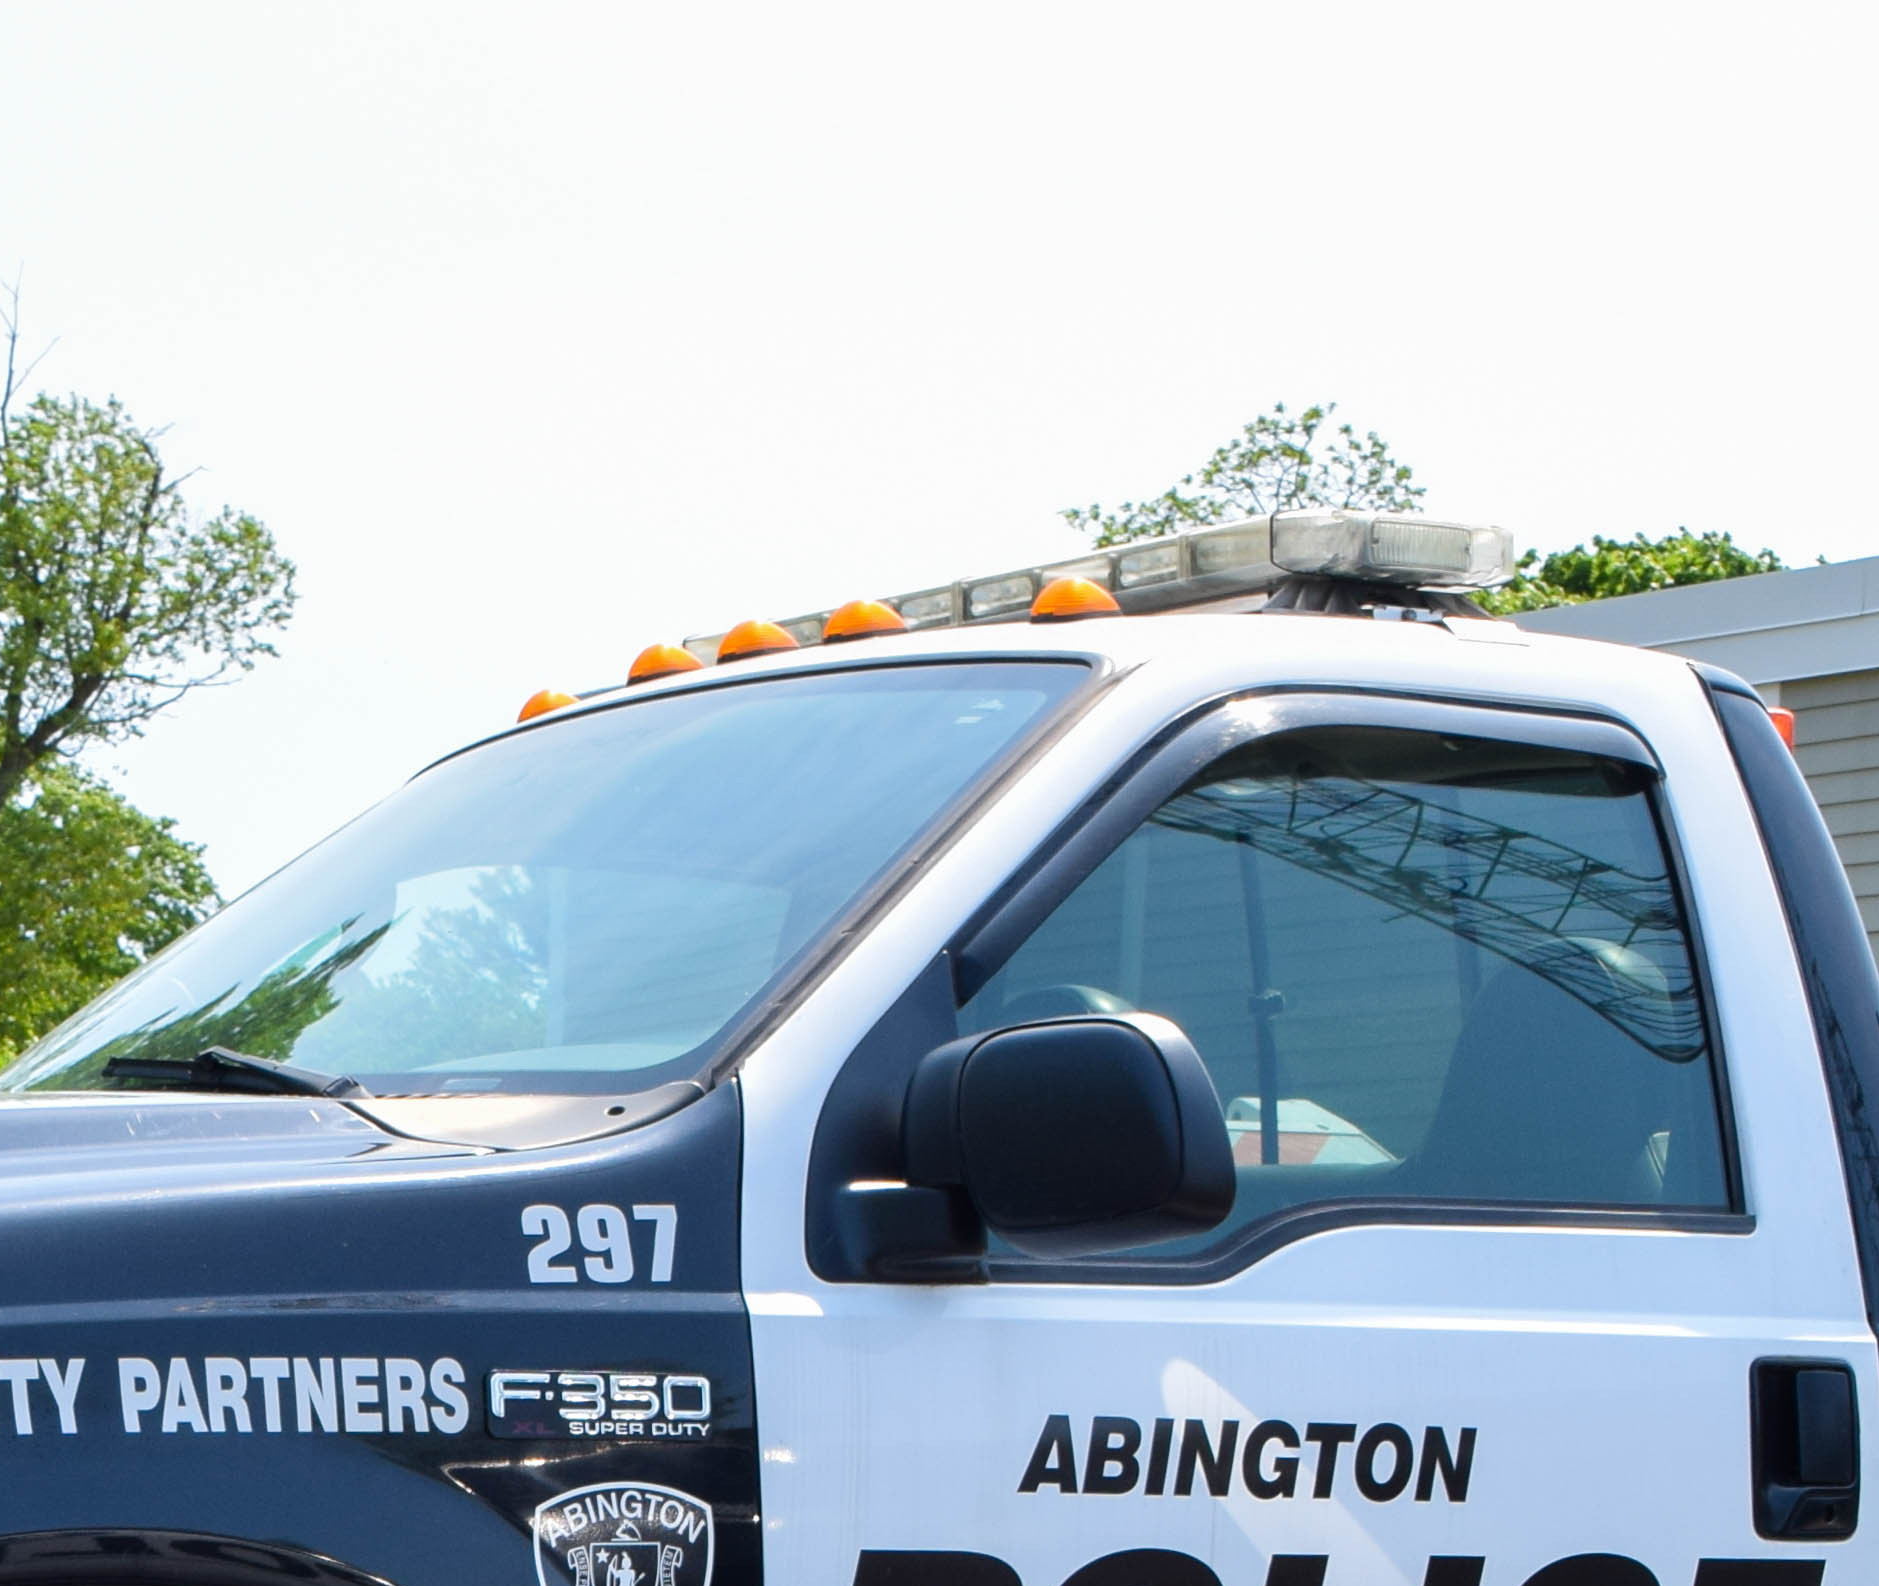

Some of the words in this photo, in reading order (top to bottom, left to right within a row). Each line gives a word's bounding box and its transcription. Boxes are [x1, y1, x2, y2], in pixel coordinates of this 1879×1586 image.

[521, 1204, 677, 1283] 297
[118, 1357, 470, 1434] PARTNERS
[569, 1422, 644, 1435] SUPER
[652, 1422, 711, 1436] DUTY
[1017, 1414, 1478, 1503] ABINGTON
[547, 1490, 706, 1549] ABINGTON
